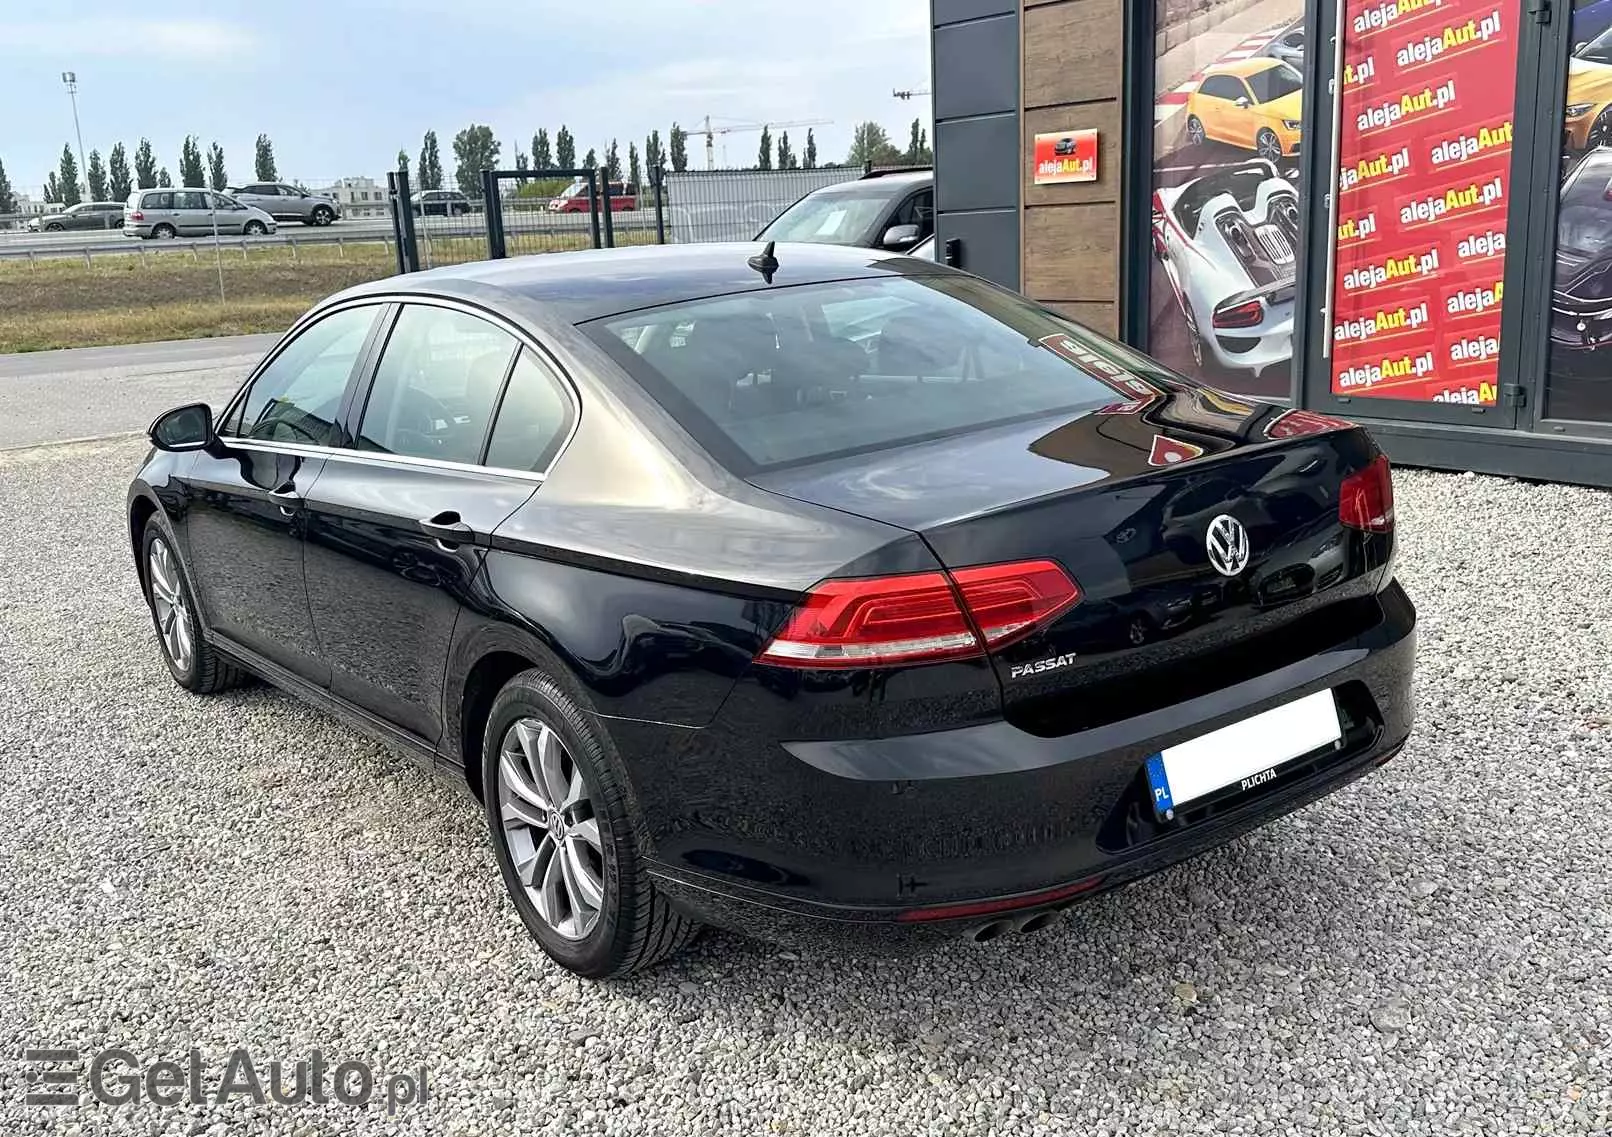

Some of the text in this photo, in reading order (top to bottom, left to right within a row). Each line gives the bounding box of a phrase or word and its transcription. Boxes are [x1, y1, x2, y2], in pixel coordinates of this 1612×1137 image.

[1396, 11, 1501, 66] alejaAut.pl
[1356, 80, 1456, 132] alejaAut.pl
[1039, 156, 1093, 176] alejaAut.pl
[1339, 148, 1410, 191] jaAut.pl
[1400, 178, 1503, 224] alejaAut.pl
[1343, 249, 1439, 290] alejaAut.pl
[1334, 303, 1428, 341] alejaAut.pl
[1339, 351, 1434, 387] alejaAut.pl
[1010, 652, 1077, 679] PASSAT
[1154, 786, 1170, 802] PL
[1241, 768, 1277, 791] PLICHTA
